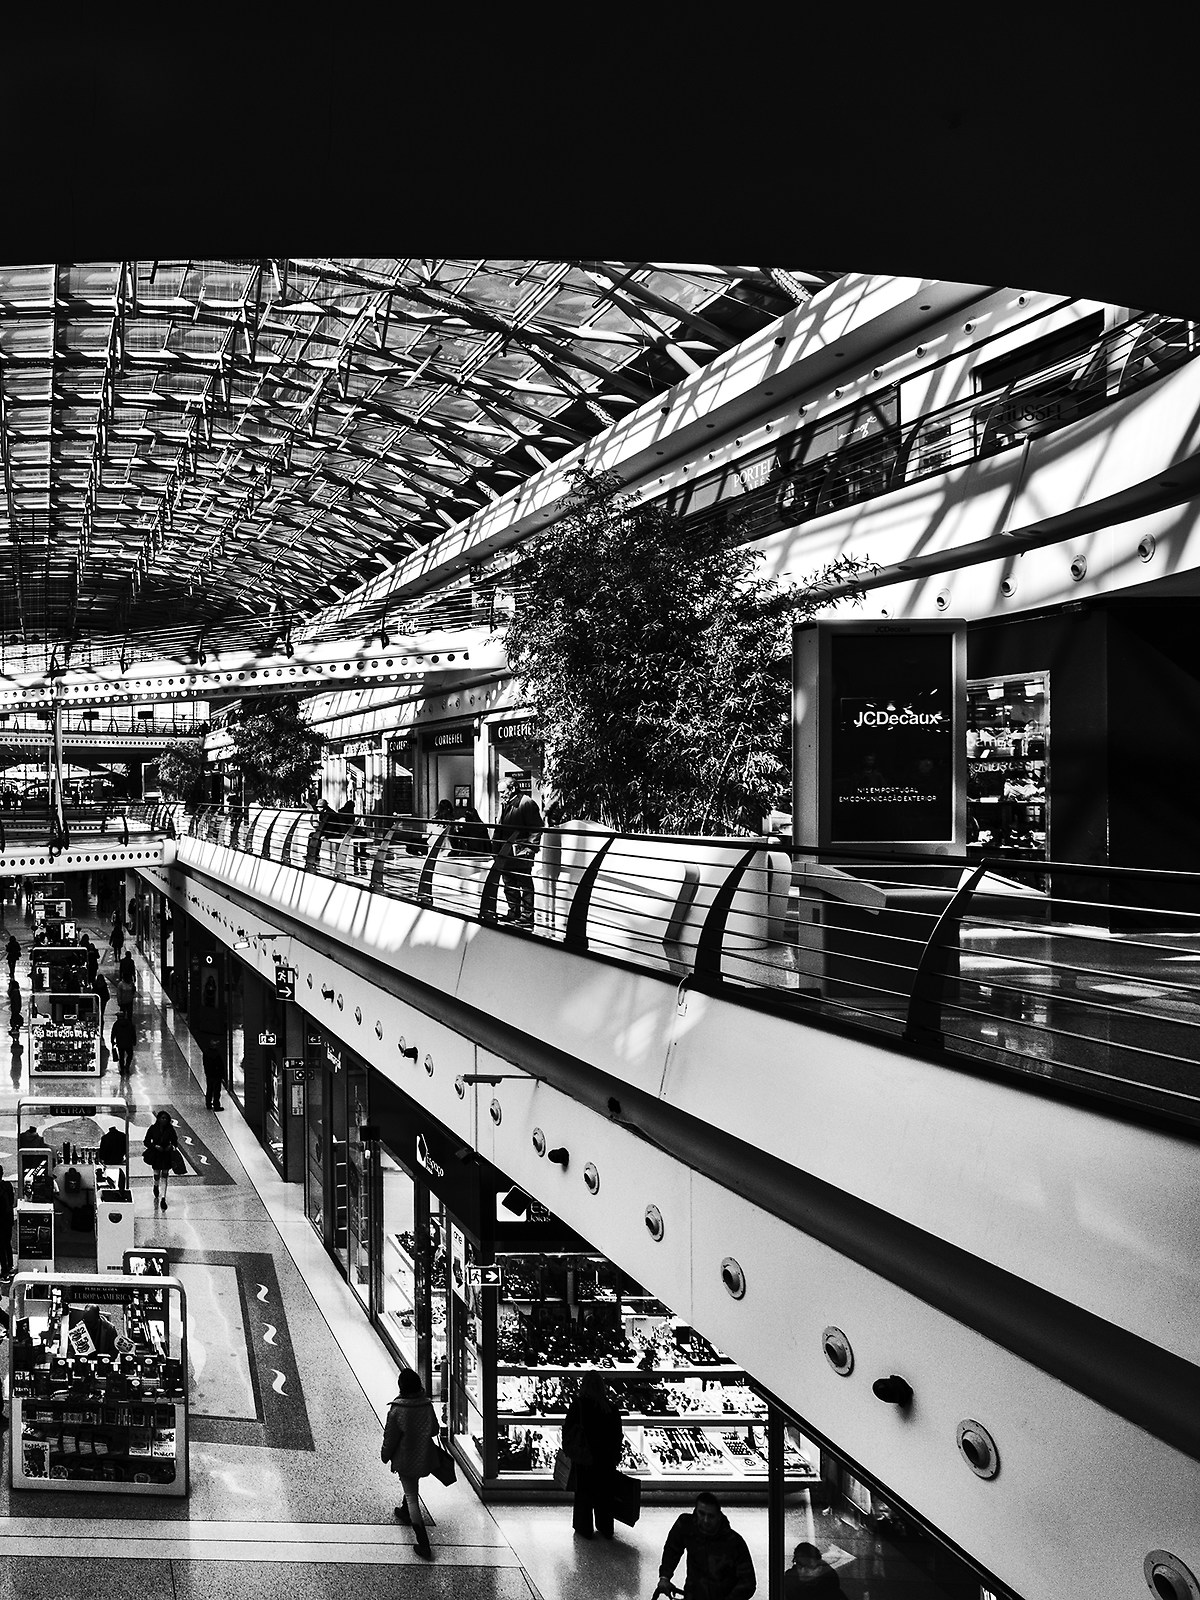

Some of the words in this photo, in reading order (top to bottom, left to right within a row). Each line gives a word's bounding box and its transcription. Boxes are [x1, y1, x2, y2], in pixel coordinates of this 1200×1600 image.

[733, 456, 781, 488] PORTELA
[853, 711, 939, 727] JCDecaux
[434, 732, 464, 747] CORTEFIEL
[54, 1105, 86, 1115] TETRA
